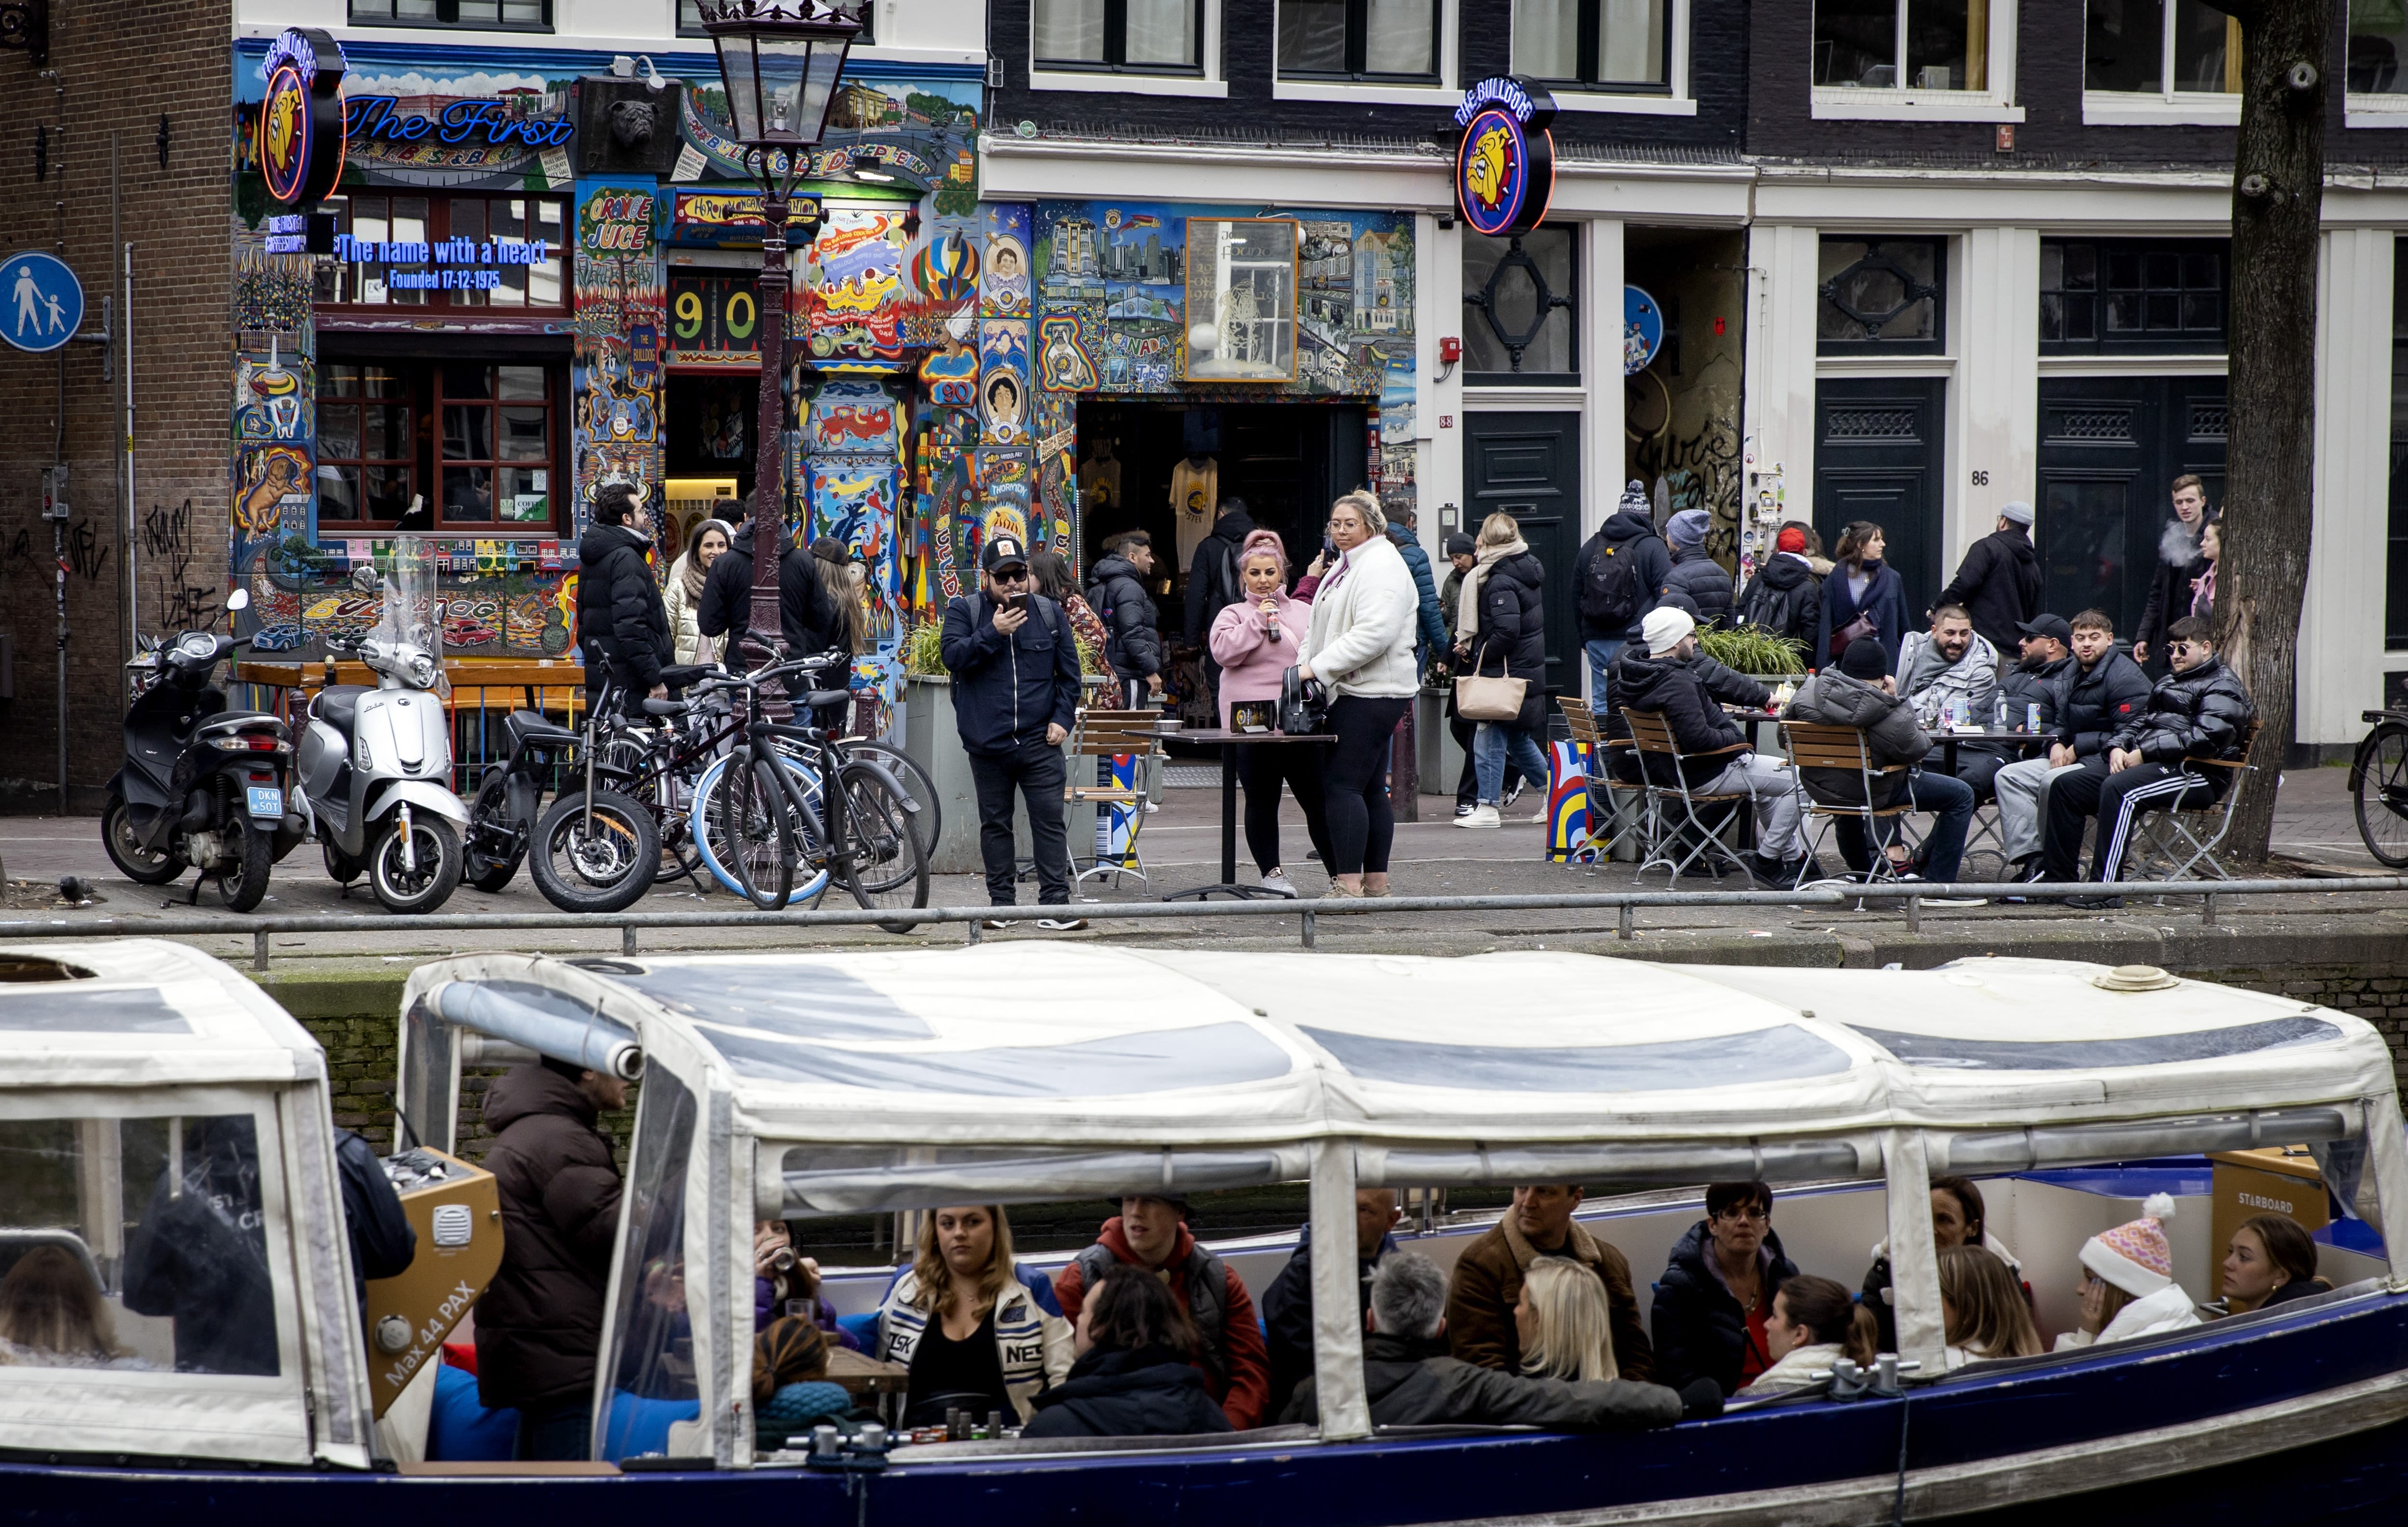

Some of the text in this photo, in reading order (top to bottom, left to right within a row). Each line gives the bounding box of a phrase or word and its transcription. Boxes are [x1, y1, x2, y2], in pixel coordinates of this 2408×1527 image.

[1477, 78, 1531, 120] BULLDOG
[338, 95, 574, 145] The First
[398, 145, 450, 165] BEST
[545, 160, 567, 173] DECORATE
[559, 167, 570, 175] HALL
[590, 195, 654, 221] ORANGE
[587, 224, 649, 249] JUICE
[831, 233, 853, 244] BULLDOG
[339, 234, 548, 264] The name with a heart
[832, 257, 854, 271] BULLDOG
[389, 269, 500, 289] Founded 17-12-1975
[675, 291, 756, 339] 90
[640, 334, 649, 344] THE
[851, 329, 864, 338] BIKE
[1112, 332, 1169, 357] CANADA
[633, 348, 655, 362] BULLDOG
[942, 382, 969, 402] 90
[1440, 416, 1452, 428] 88
[984, 454, 999, 464] WORLD
[982, 461, 1014, 483] HAROLD
[1001, 462, 1027, 483] KANGAROO
[1971, 470, 1989, 487] 86
[992, 483, 1029, 497] THORNTON
[258, 790, 278, 801] DKN
[2238, 1192, 2293, 1214] STARBOARD
[385, 1343, 426, 1387] Max
[419, 1317, 445, 1342] 44
[439, 1279, 476, 1320] PAX
